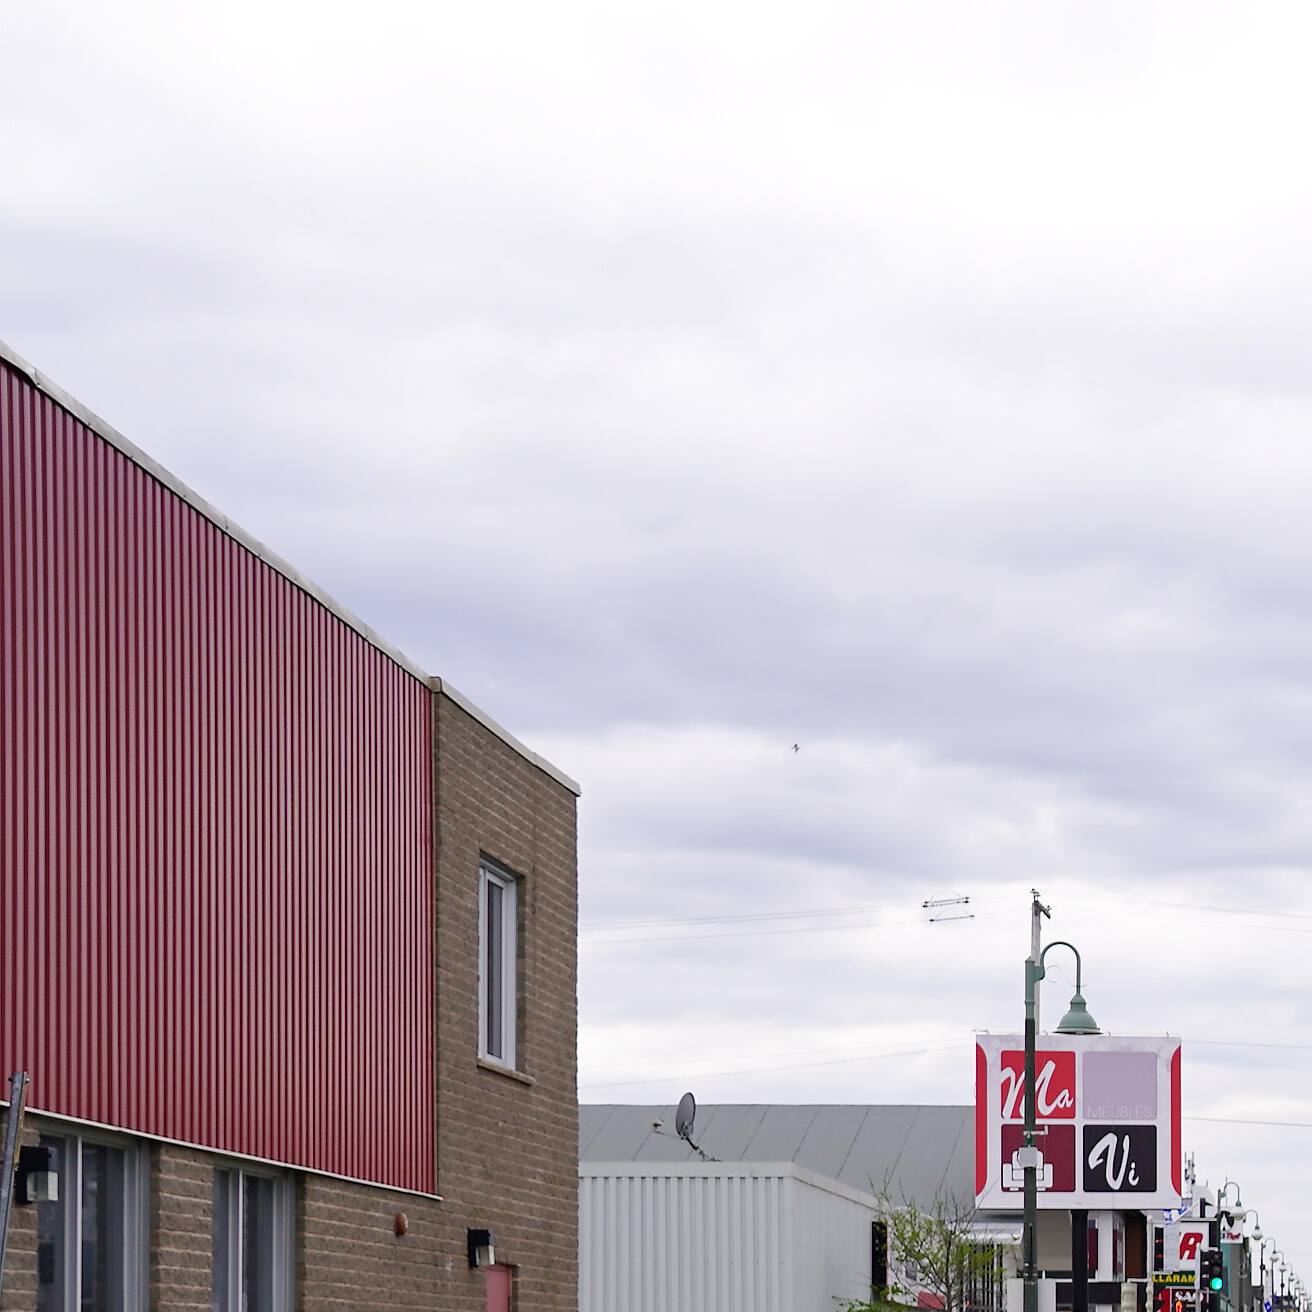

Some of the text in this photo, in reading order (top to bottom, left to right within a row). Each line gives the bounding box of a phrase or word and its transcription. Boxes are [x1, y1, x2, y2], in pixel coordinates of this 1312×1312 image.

[1001, 1060, 1074, 1118] Ma
[1087, 1105, 1153, 1118] MEUBLES
[1088, 1132, 1139, 1190] Vi
